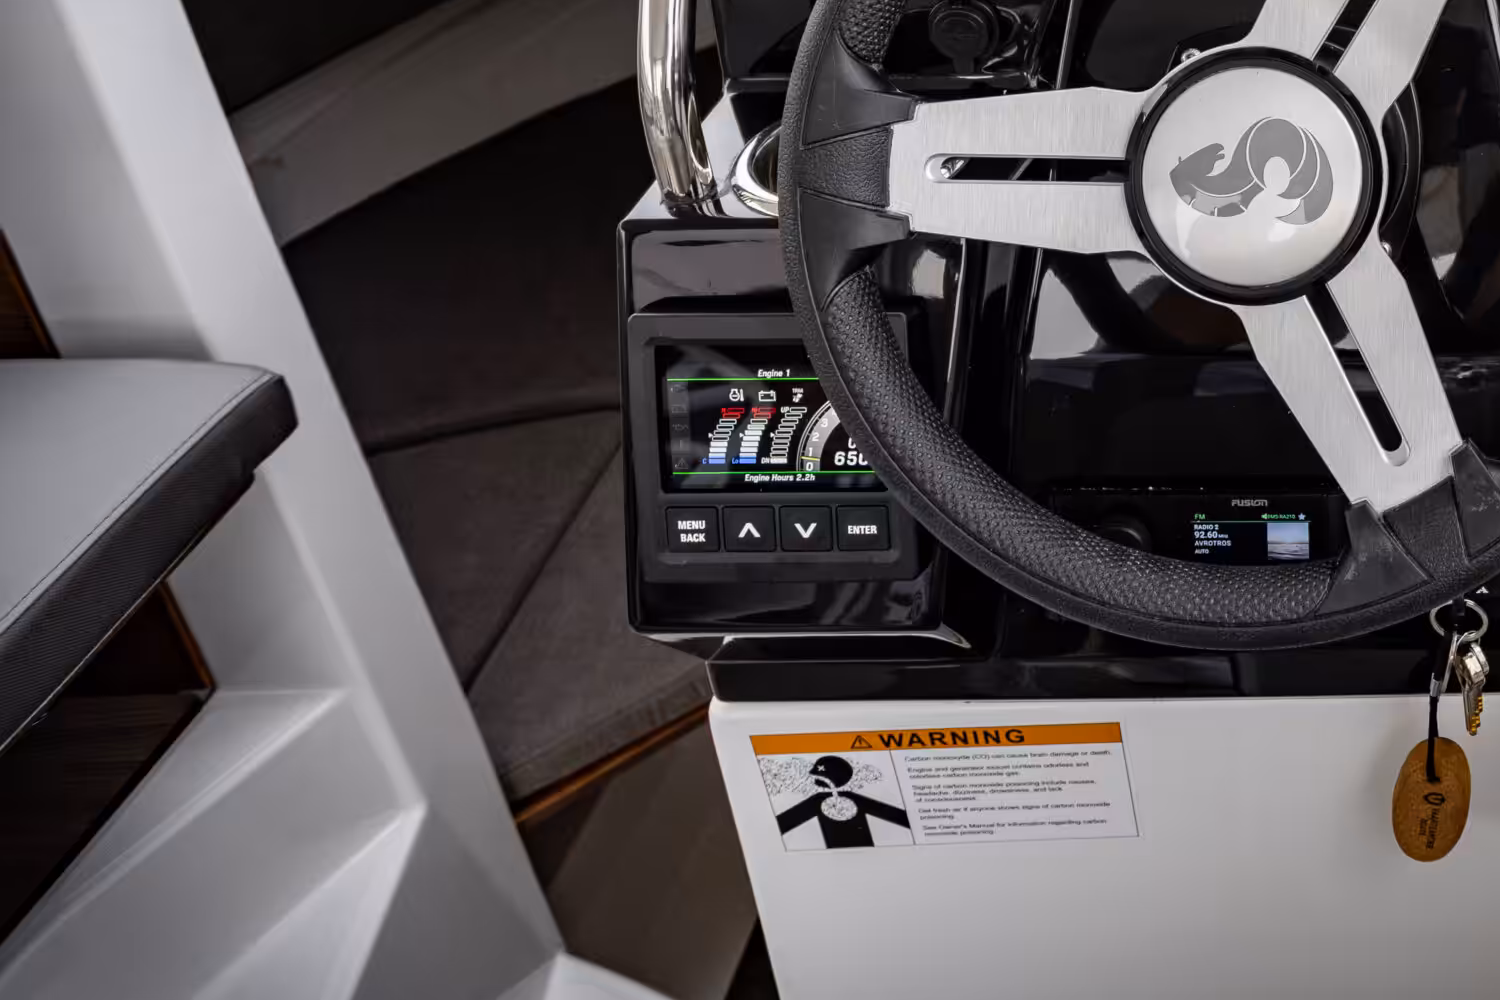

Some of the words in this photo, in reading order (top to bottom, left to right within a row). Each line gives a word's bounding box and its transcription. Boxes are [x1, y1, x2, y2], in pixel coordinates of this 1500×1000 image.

[758, 368, 783, 379] Engine
[821, 418, 828, 428] 3
[812, 433, 820, 442] 2
[808, 447, 813, 456] 1
[806, 462, 814, 472] 0
[744, 474, 769, 484] Engine
[772, 474, 794, 482] Hours
[796, 474, 816, 482] 2.2h
[678, 520, 706, 531] MENU
[847, 524, 878, 536] ENTER
[680, 532, 706, 543] BACK
[1194, 531, 1218, 539] 92.60
[879, 728, 1026, 748] WARNING
